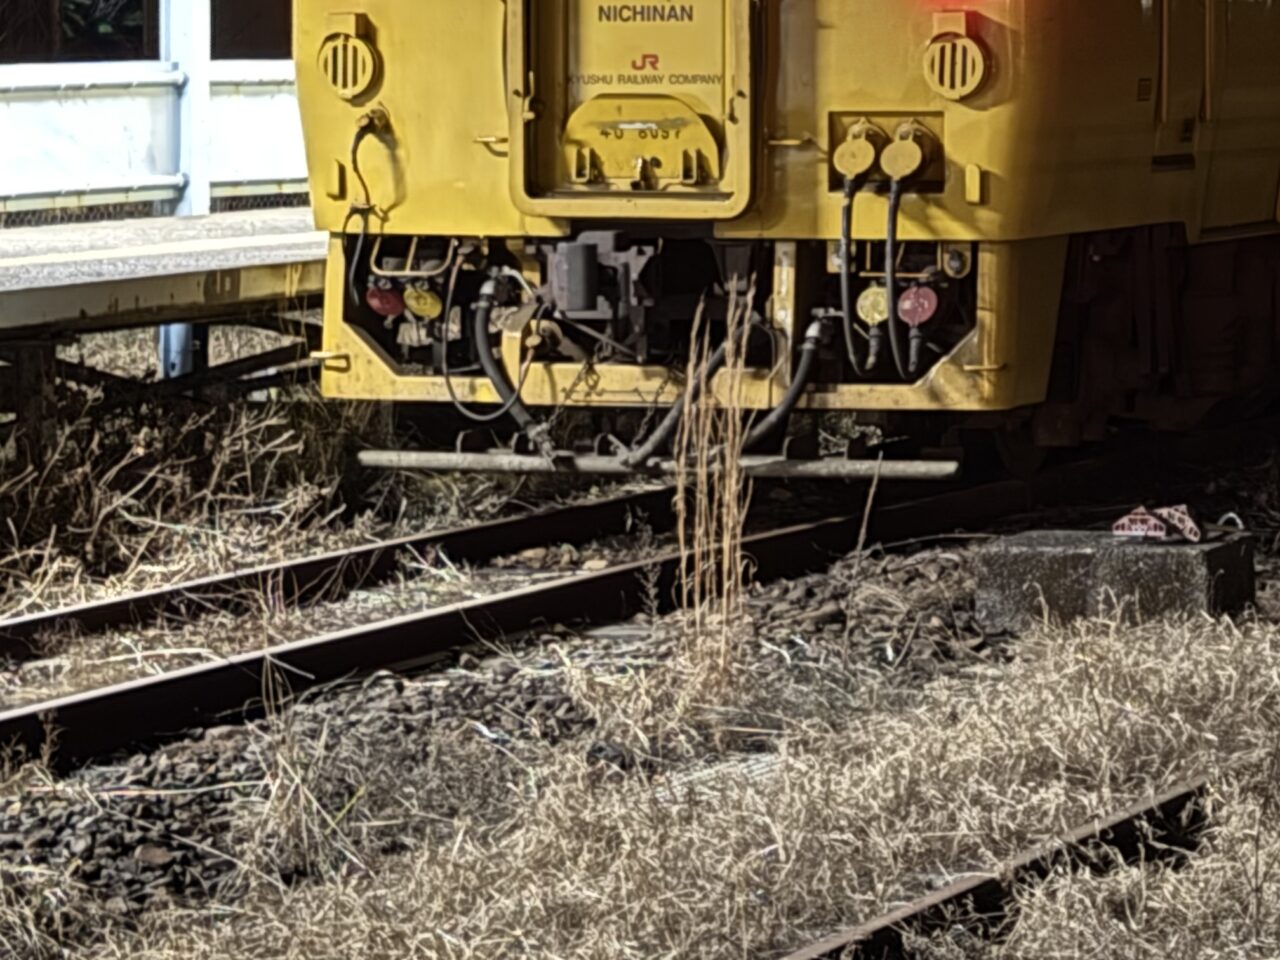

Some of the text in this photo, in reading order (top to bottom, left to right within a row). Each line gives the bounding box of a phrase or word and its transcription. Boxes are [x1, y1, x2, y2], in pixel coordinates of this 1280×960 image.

[597, 4, 694, 22] NICHINAN
[631, 54, 659, 70] JR
[617, 74, 665, 85] RAILWAY
[668, 74, 723, 85] COMPANY
